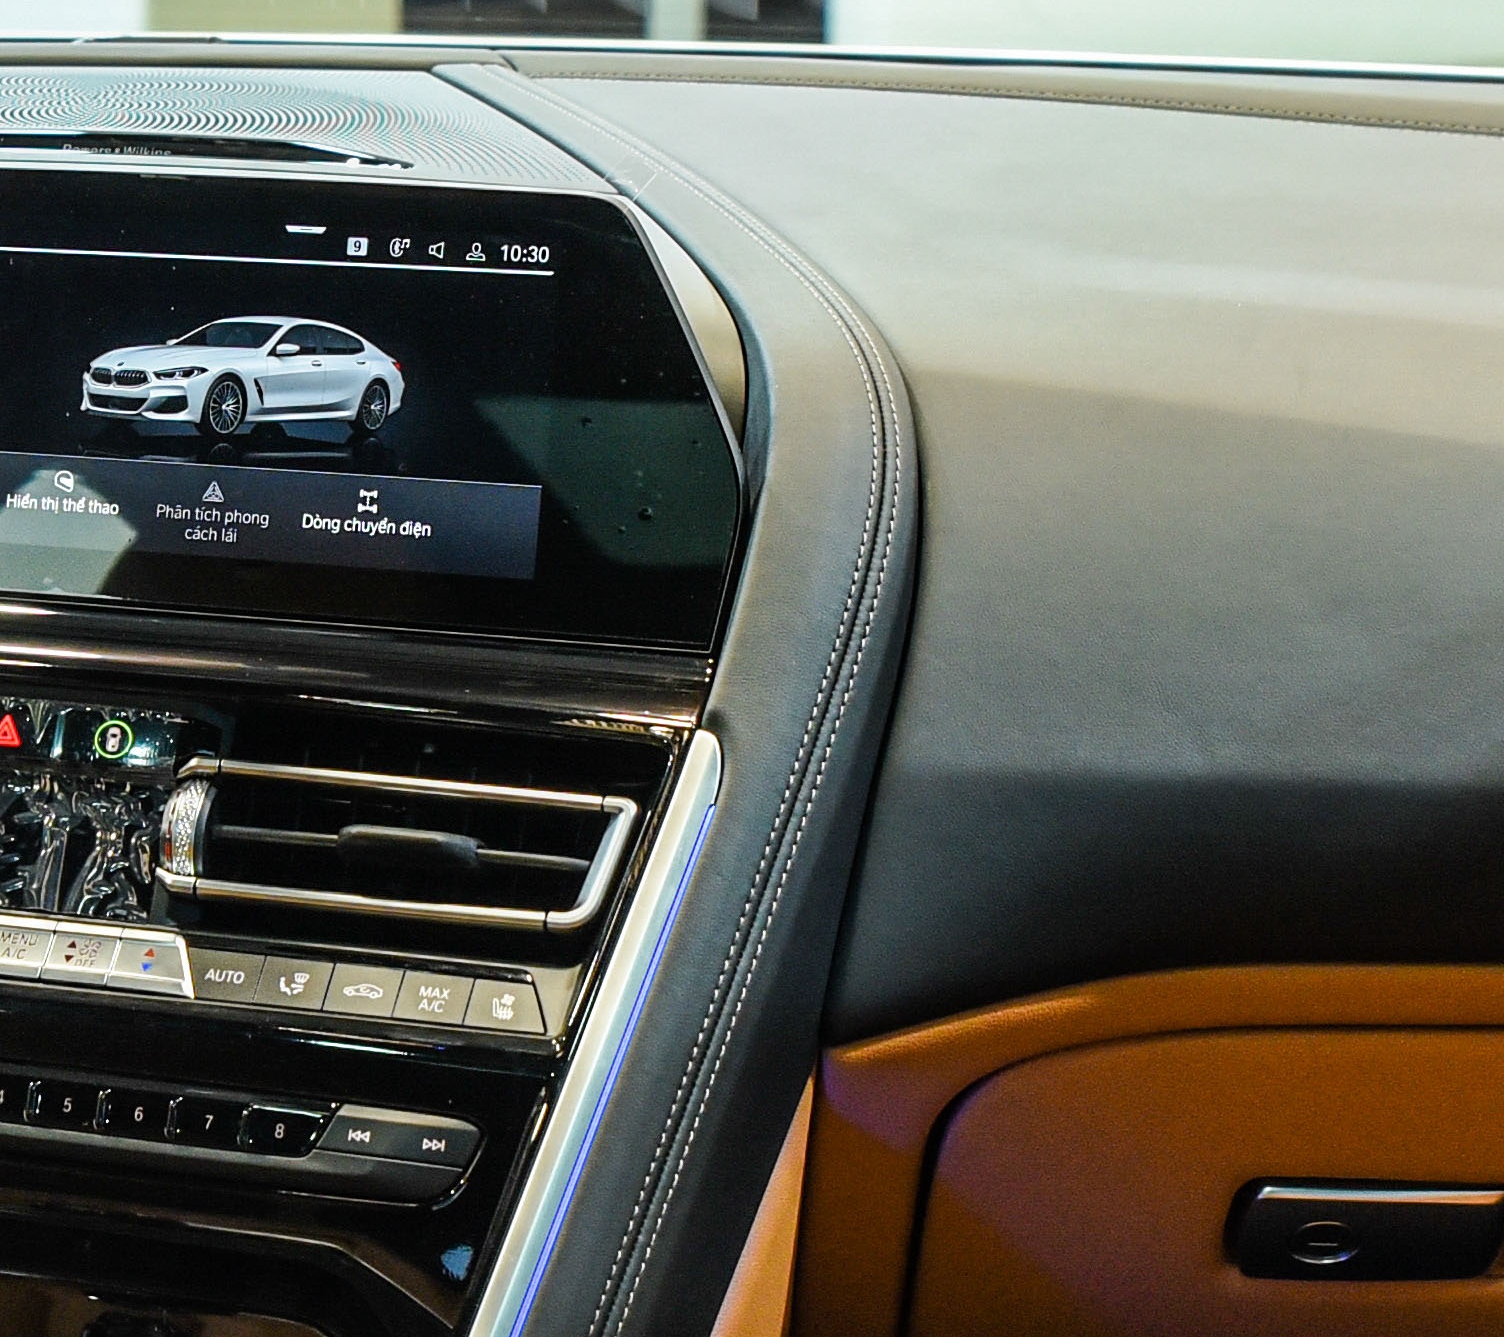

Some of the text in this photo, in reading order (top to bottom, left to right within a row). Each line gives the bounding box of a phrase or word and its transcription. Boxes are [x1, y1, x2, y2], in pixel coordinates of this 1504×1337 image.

[500, 244, 550, 263] 10:30
[41, 495, 59, 515] thị
[88, 498, 120, 515] thao
[156, 503, 270, 528] Phân tích phong
[184, 525, 238, 543] cách lái
[302, 513, 341, 534] Dòng
[400, 520, 432, 540] điện
[0, 931, 38, 946] MENU
[2, 947, 27, 961] A/C
[204, 968, 246, 985] AUTO
[418, 985, 451, 1000] MAX
[418, 999, 445, 1013] A/C
[62, 1097, 73, 1113] 5
[134, 1106, 144, 1122] 6
[204, 1114, 214, 1130] 7
[274, 1122, 285, 1139] 8
